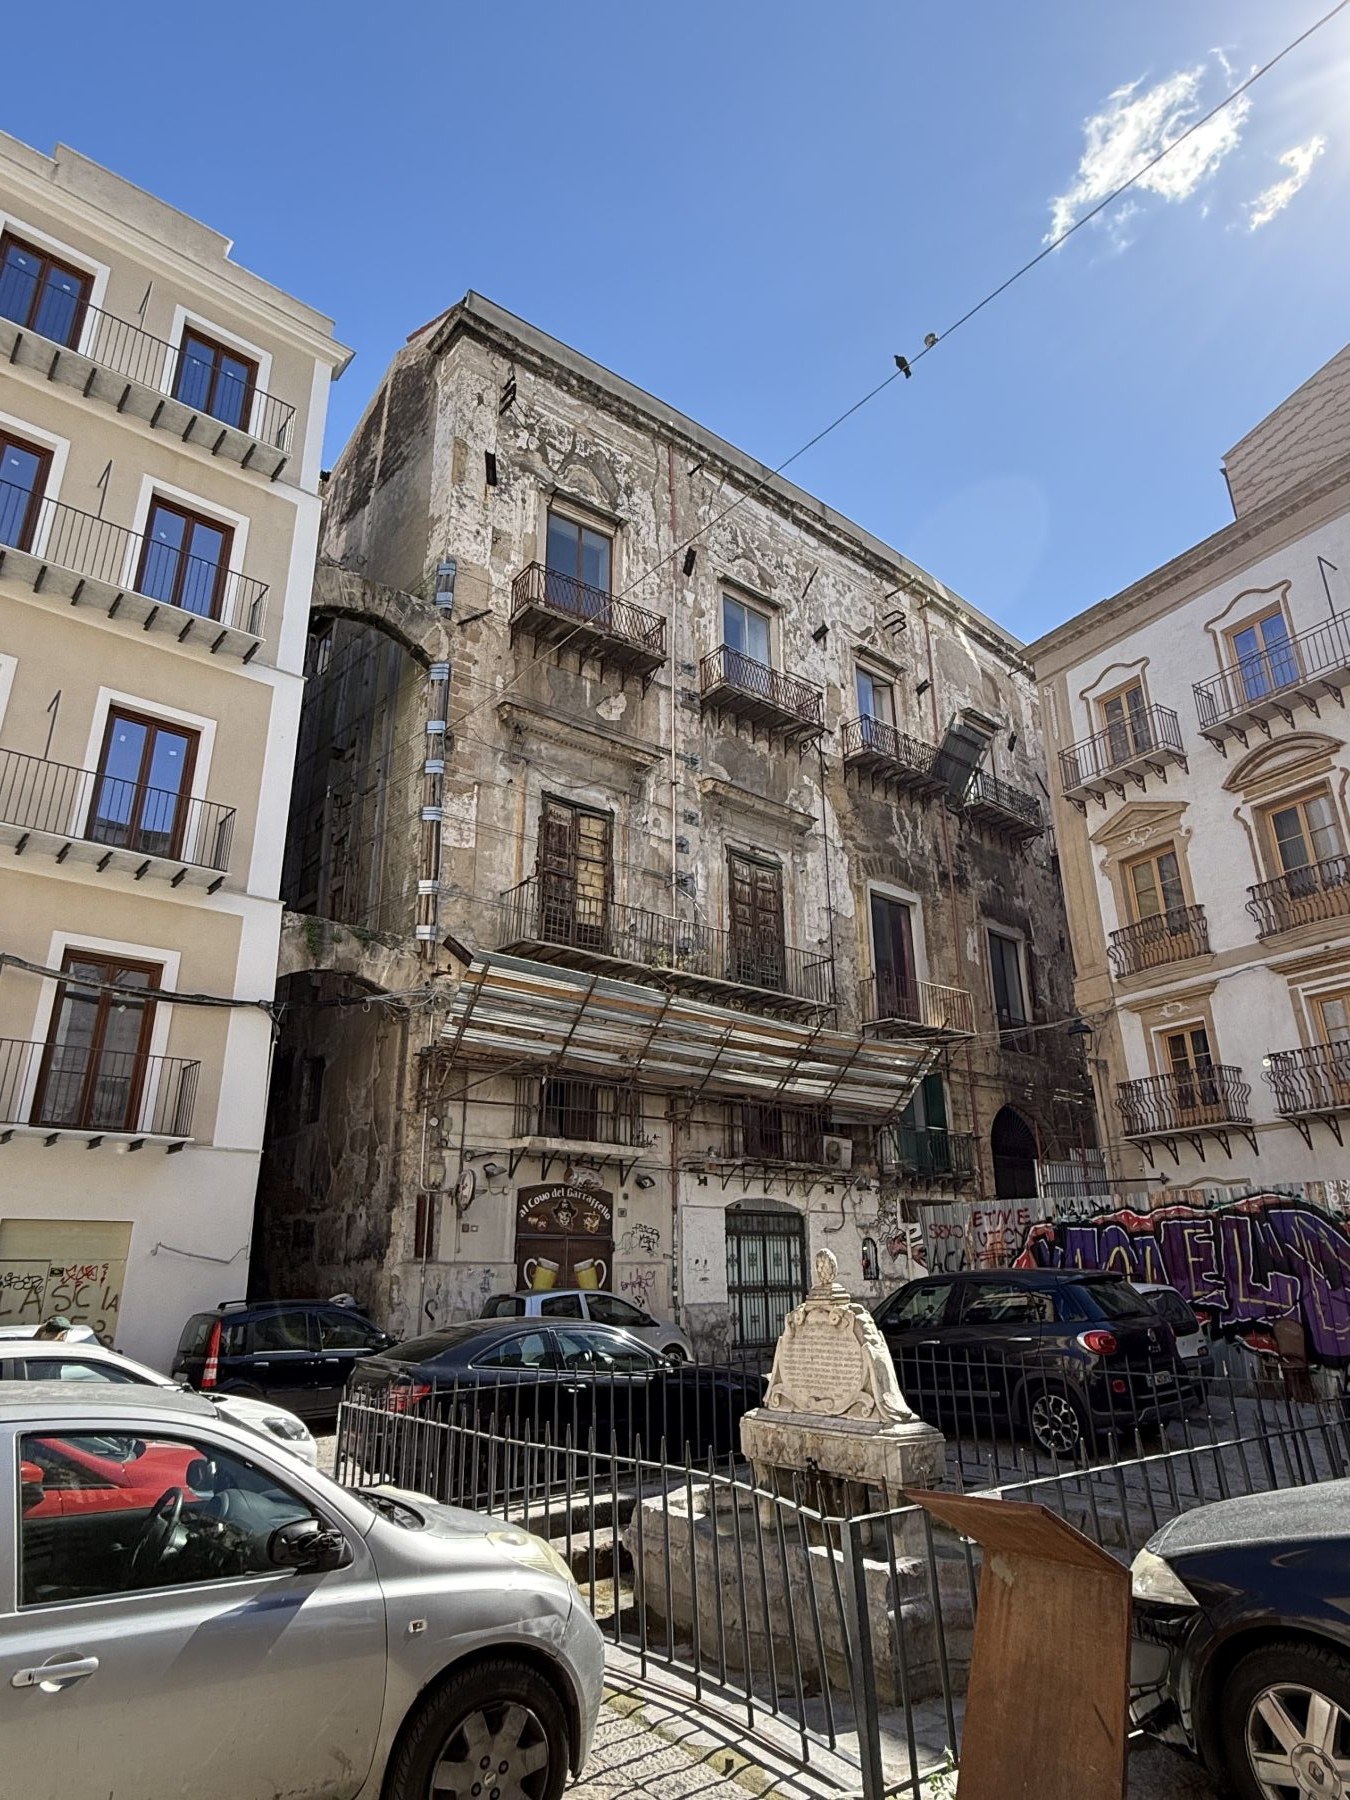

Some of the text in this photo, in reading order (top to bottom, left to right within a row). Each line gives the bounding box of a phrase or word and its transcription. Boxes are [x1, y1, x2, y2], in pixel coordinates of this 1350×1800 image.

[519, 1204, 530, 1218] al
[551, 1187, 565, 1199] del
[566, 1187, 612, 1221] Garraffello
